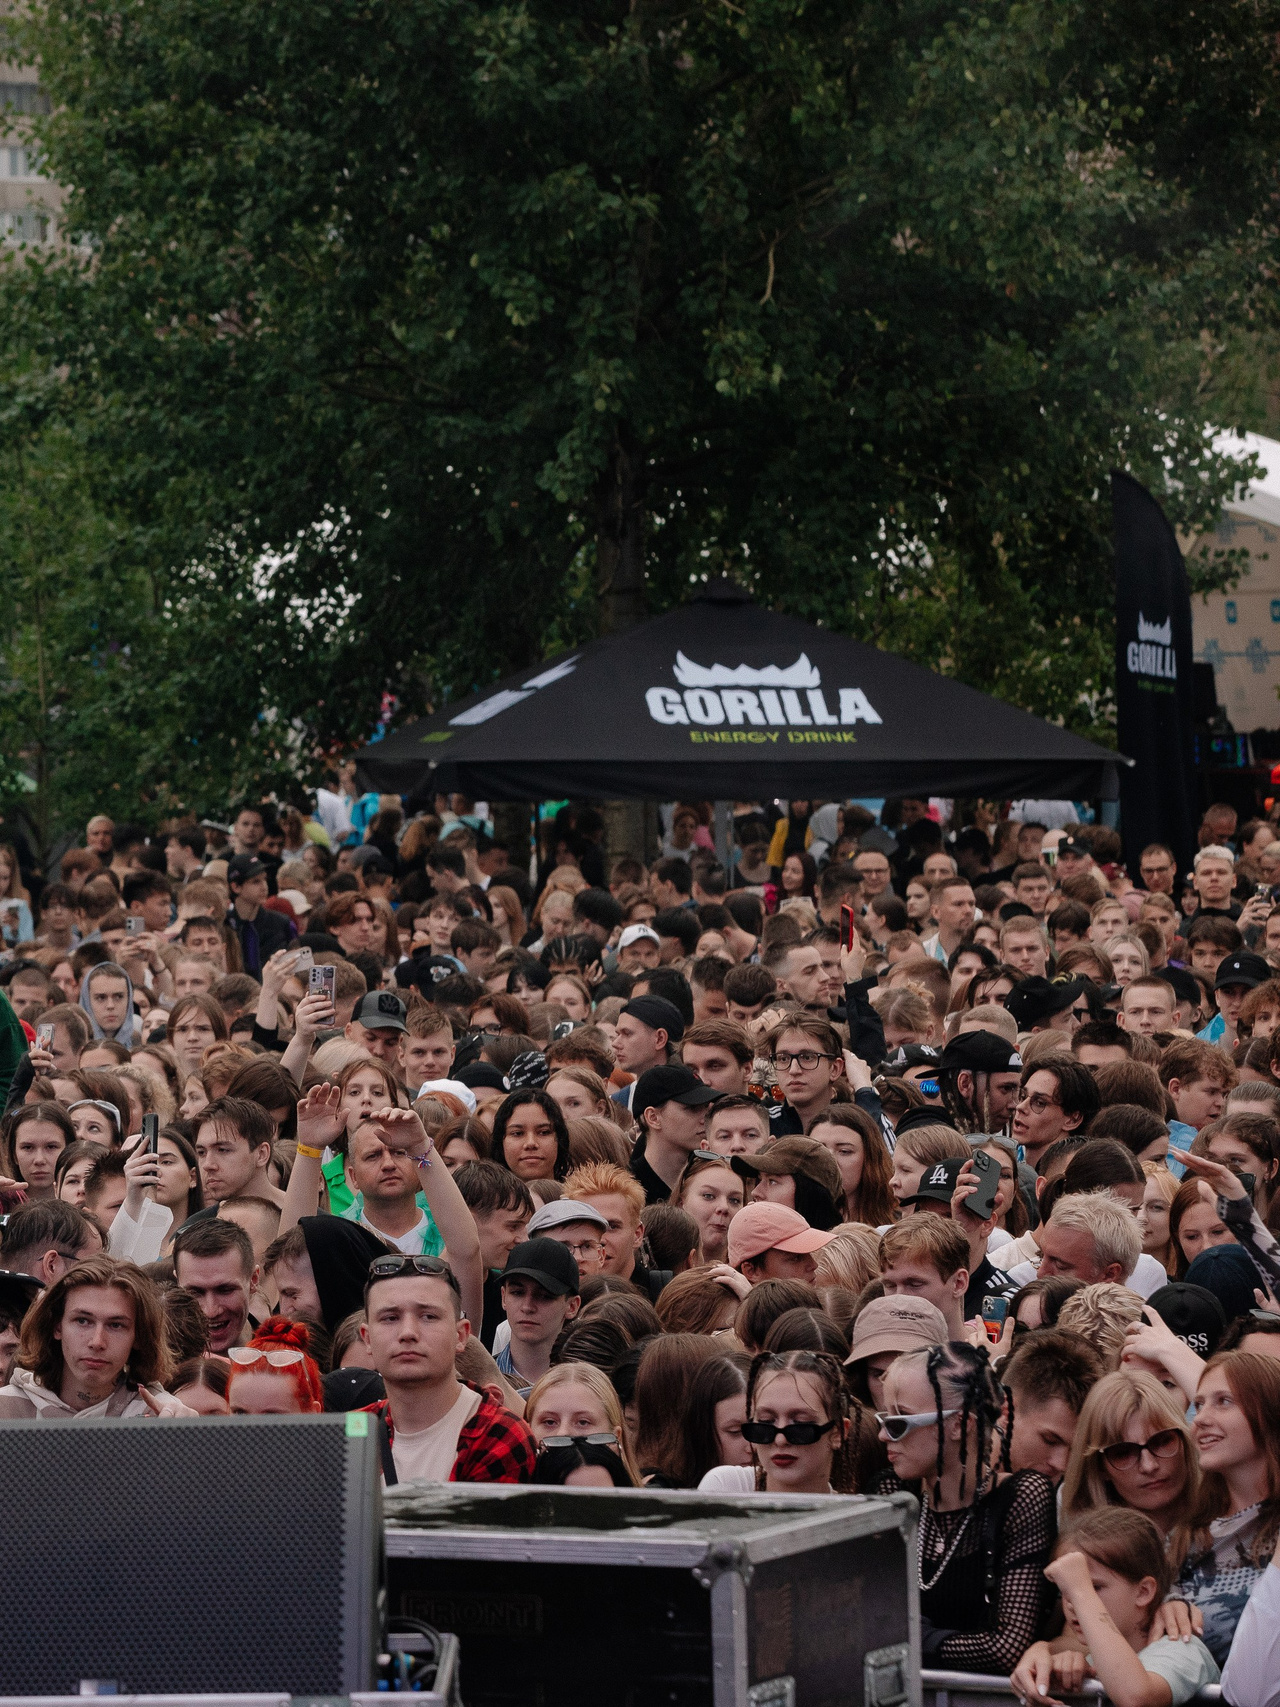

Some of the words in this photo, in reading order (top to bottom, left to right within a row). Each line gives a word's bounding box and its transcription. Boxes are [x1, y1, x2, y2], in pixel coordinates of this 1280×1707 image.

[645, 686, 883, 726] GORILLA
[689, 731, 779, 743] ENERGY
[787, 731, 857, 743] DRINK
[929, 1164, 949, 1185] LA
[889, 1310, 910, 1318] Calvin
[1176, 1332, 1209, 1348] OSS
